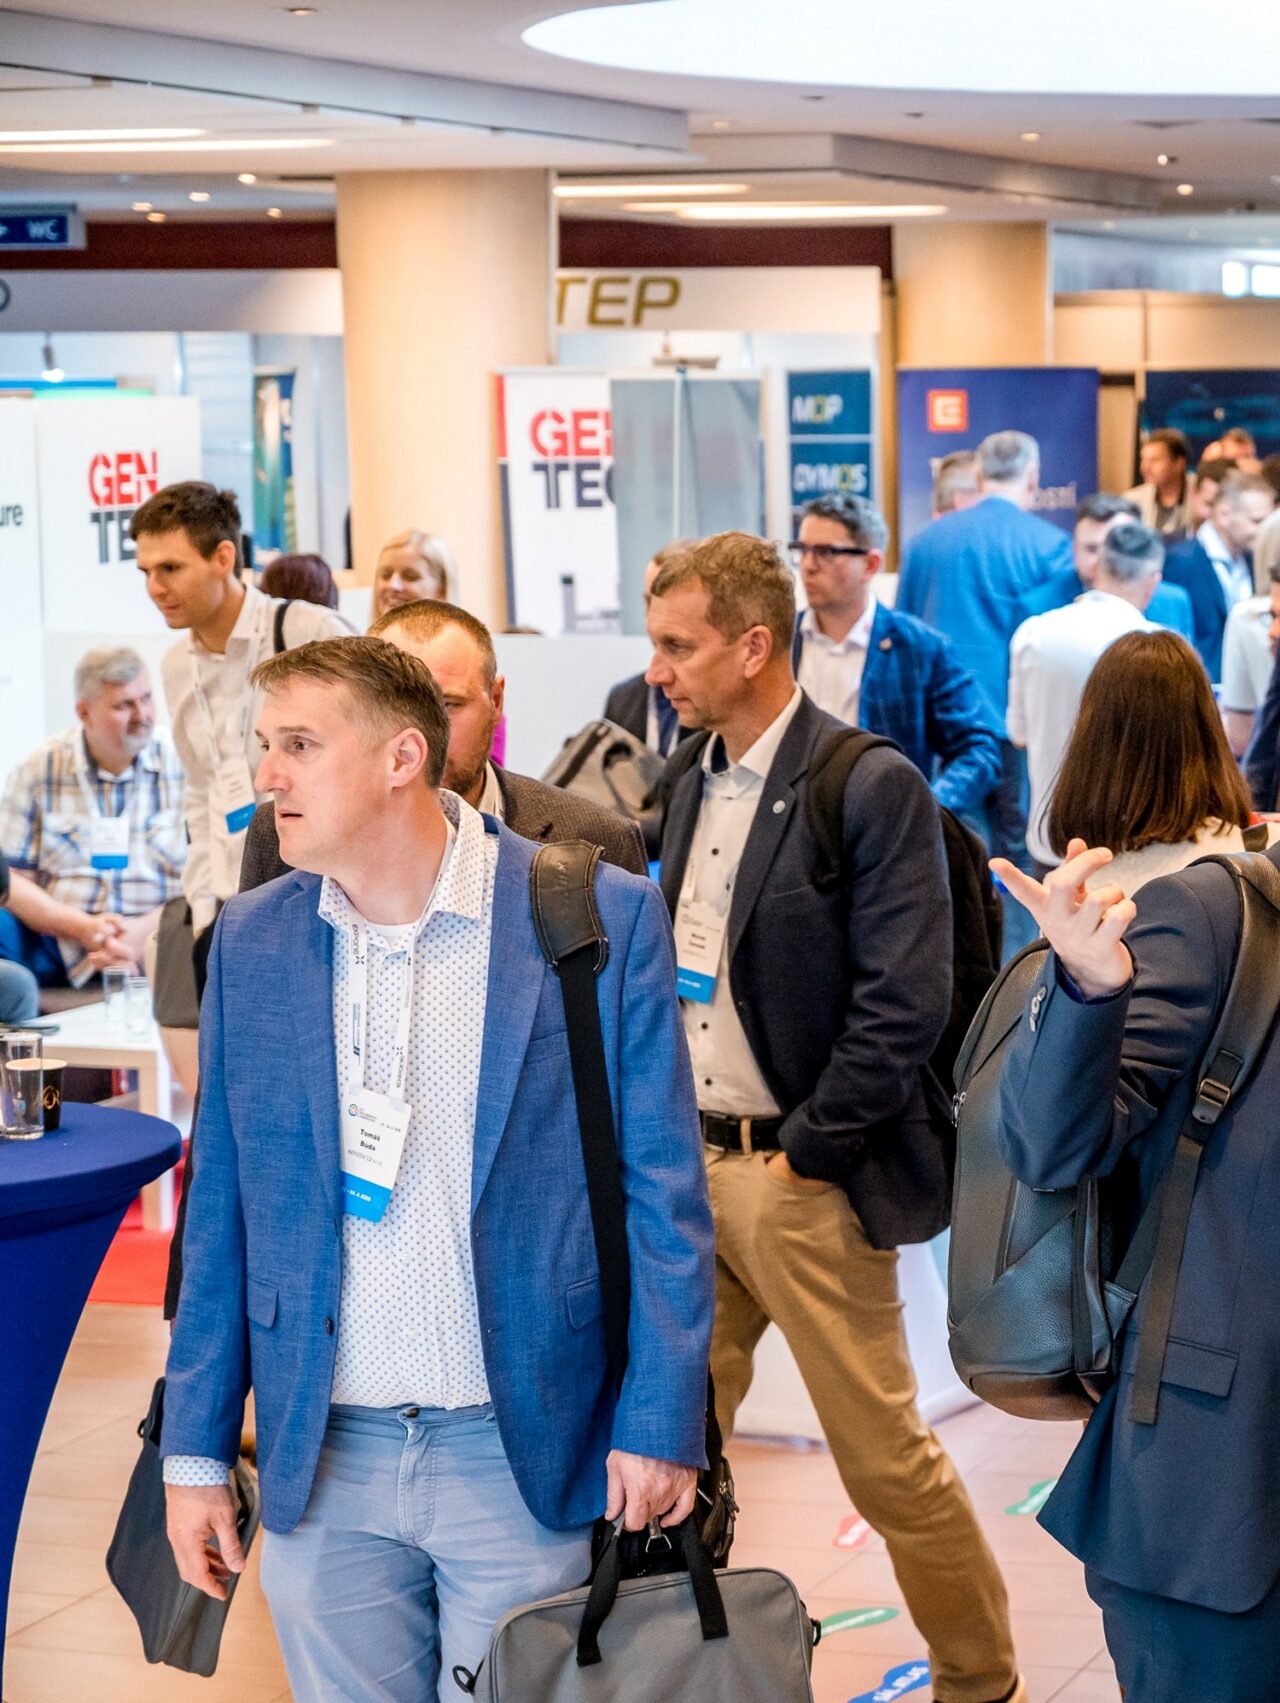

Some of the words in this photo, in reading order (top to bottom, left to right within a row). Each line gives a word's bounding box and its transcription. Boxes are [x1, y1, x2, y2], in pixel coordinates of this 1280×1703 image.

[27, 219, 58, 240] WC
[88, 449, 157, 506] GEN
[90, 510, 137, 563] TE
[360, 1128, 381, 1142] Tomáš
[360, 1140, 376, 1151] Buda
